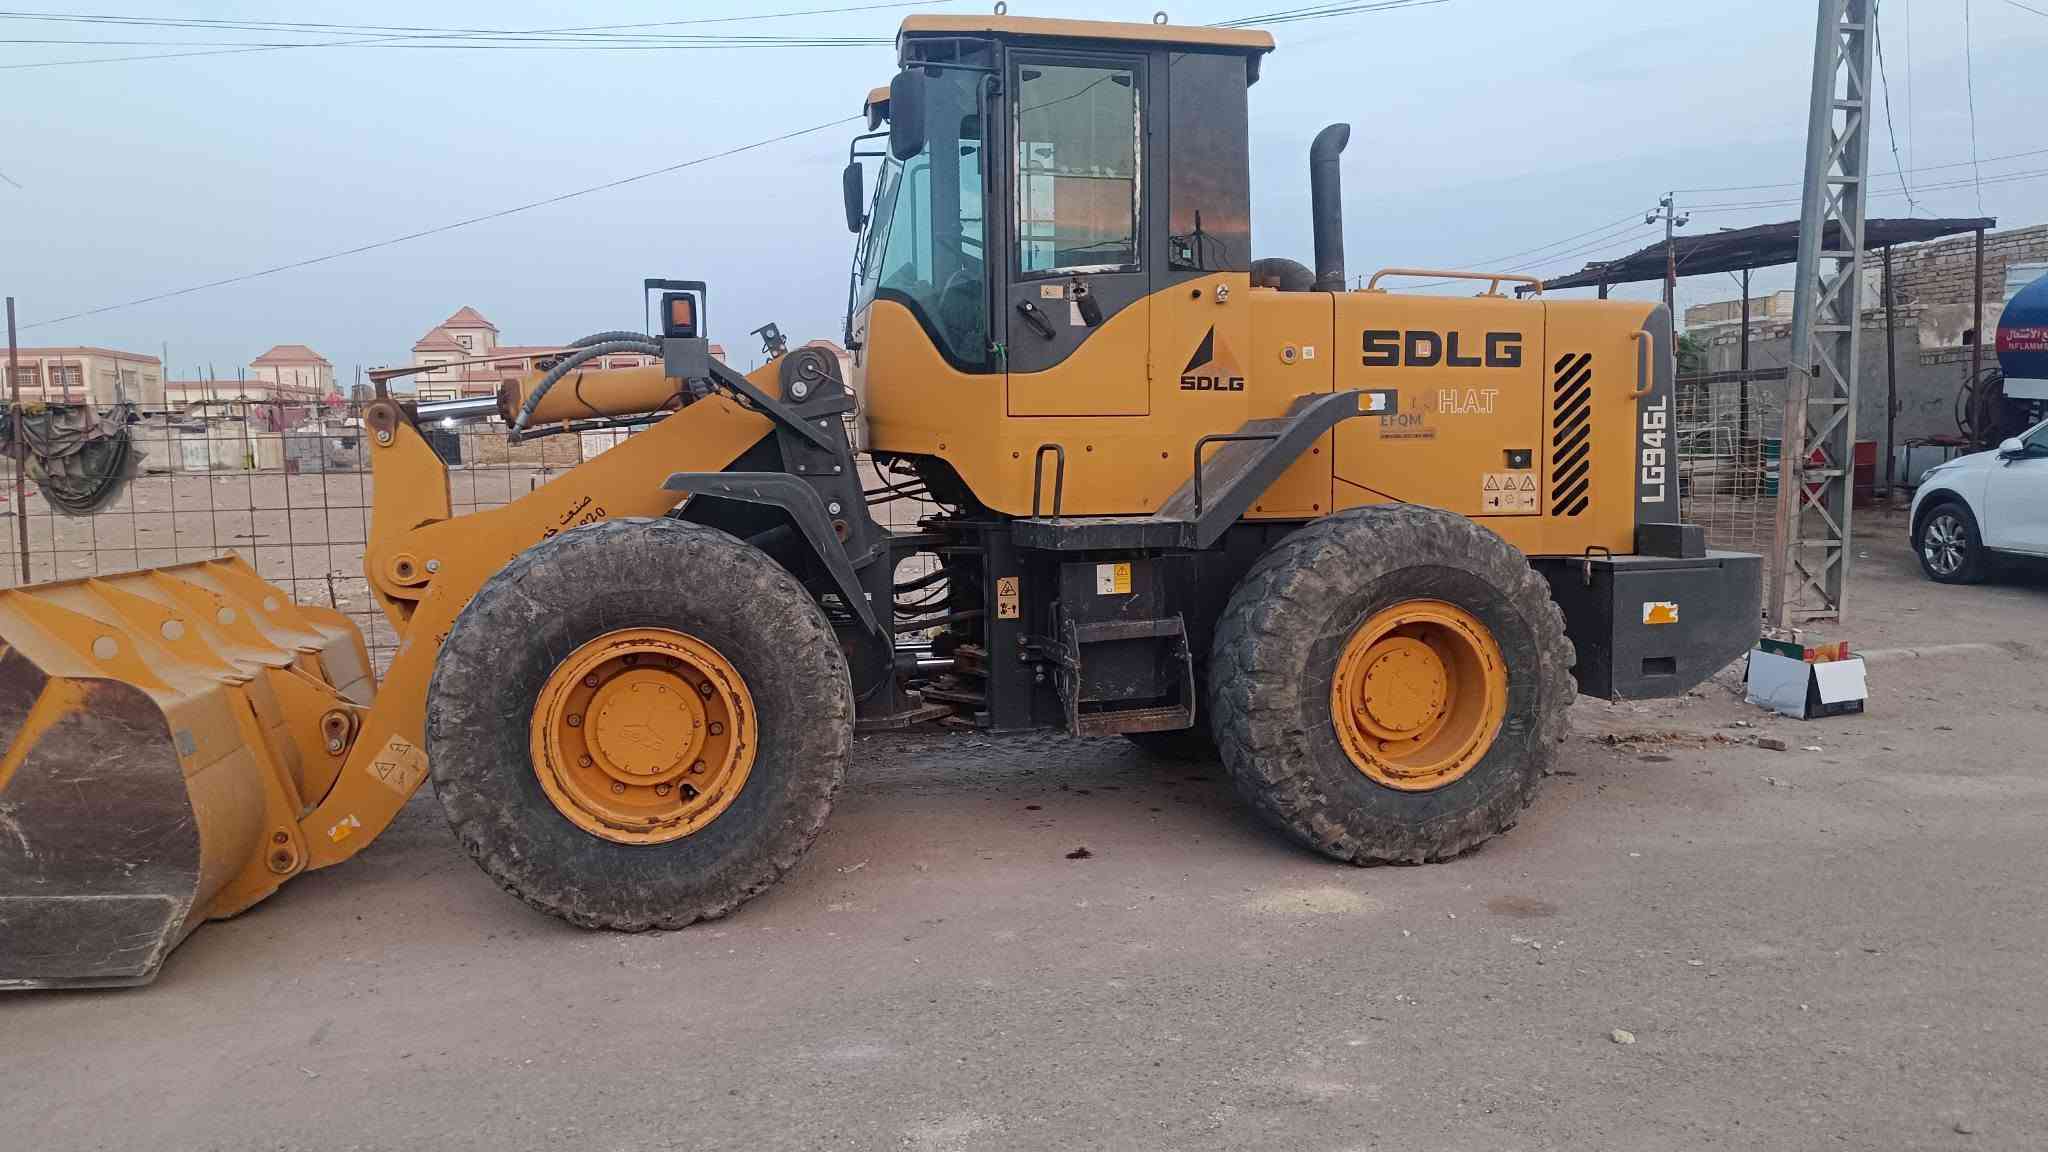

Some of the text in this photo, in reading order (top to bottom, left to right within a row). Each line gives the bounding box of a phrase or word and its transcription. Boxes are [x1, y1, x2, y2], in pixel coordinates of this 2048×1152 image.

[1363, 330, 1522, 368] SDLG
[1180, 376, 1244, 391] SDLG
[1439, 387, 1498, 415] H.A.T
[1641, 395, 1667, 502] LG946L
